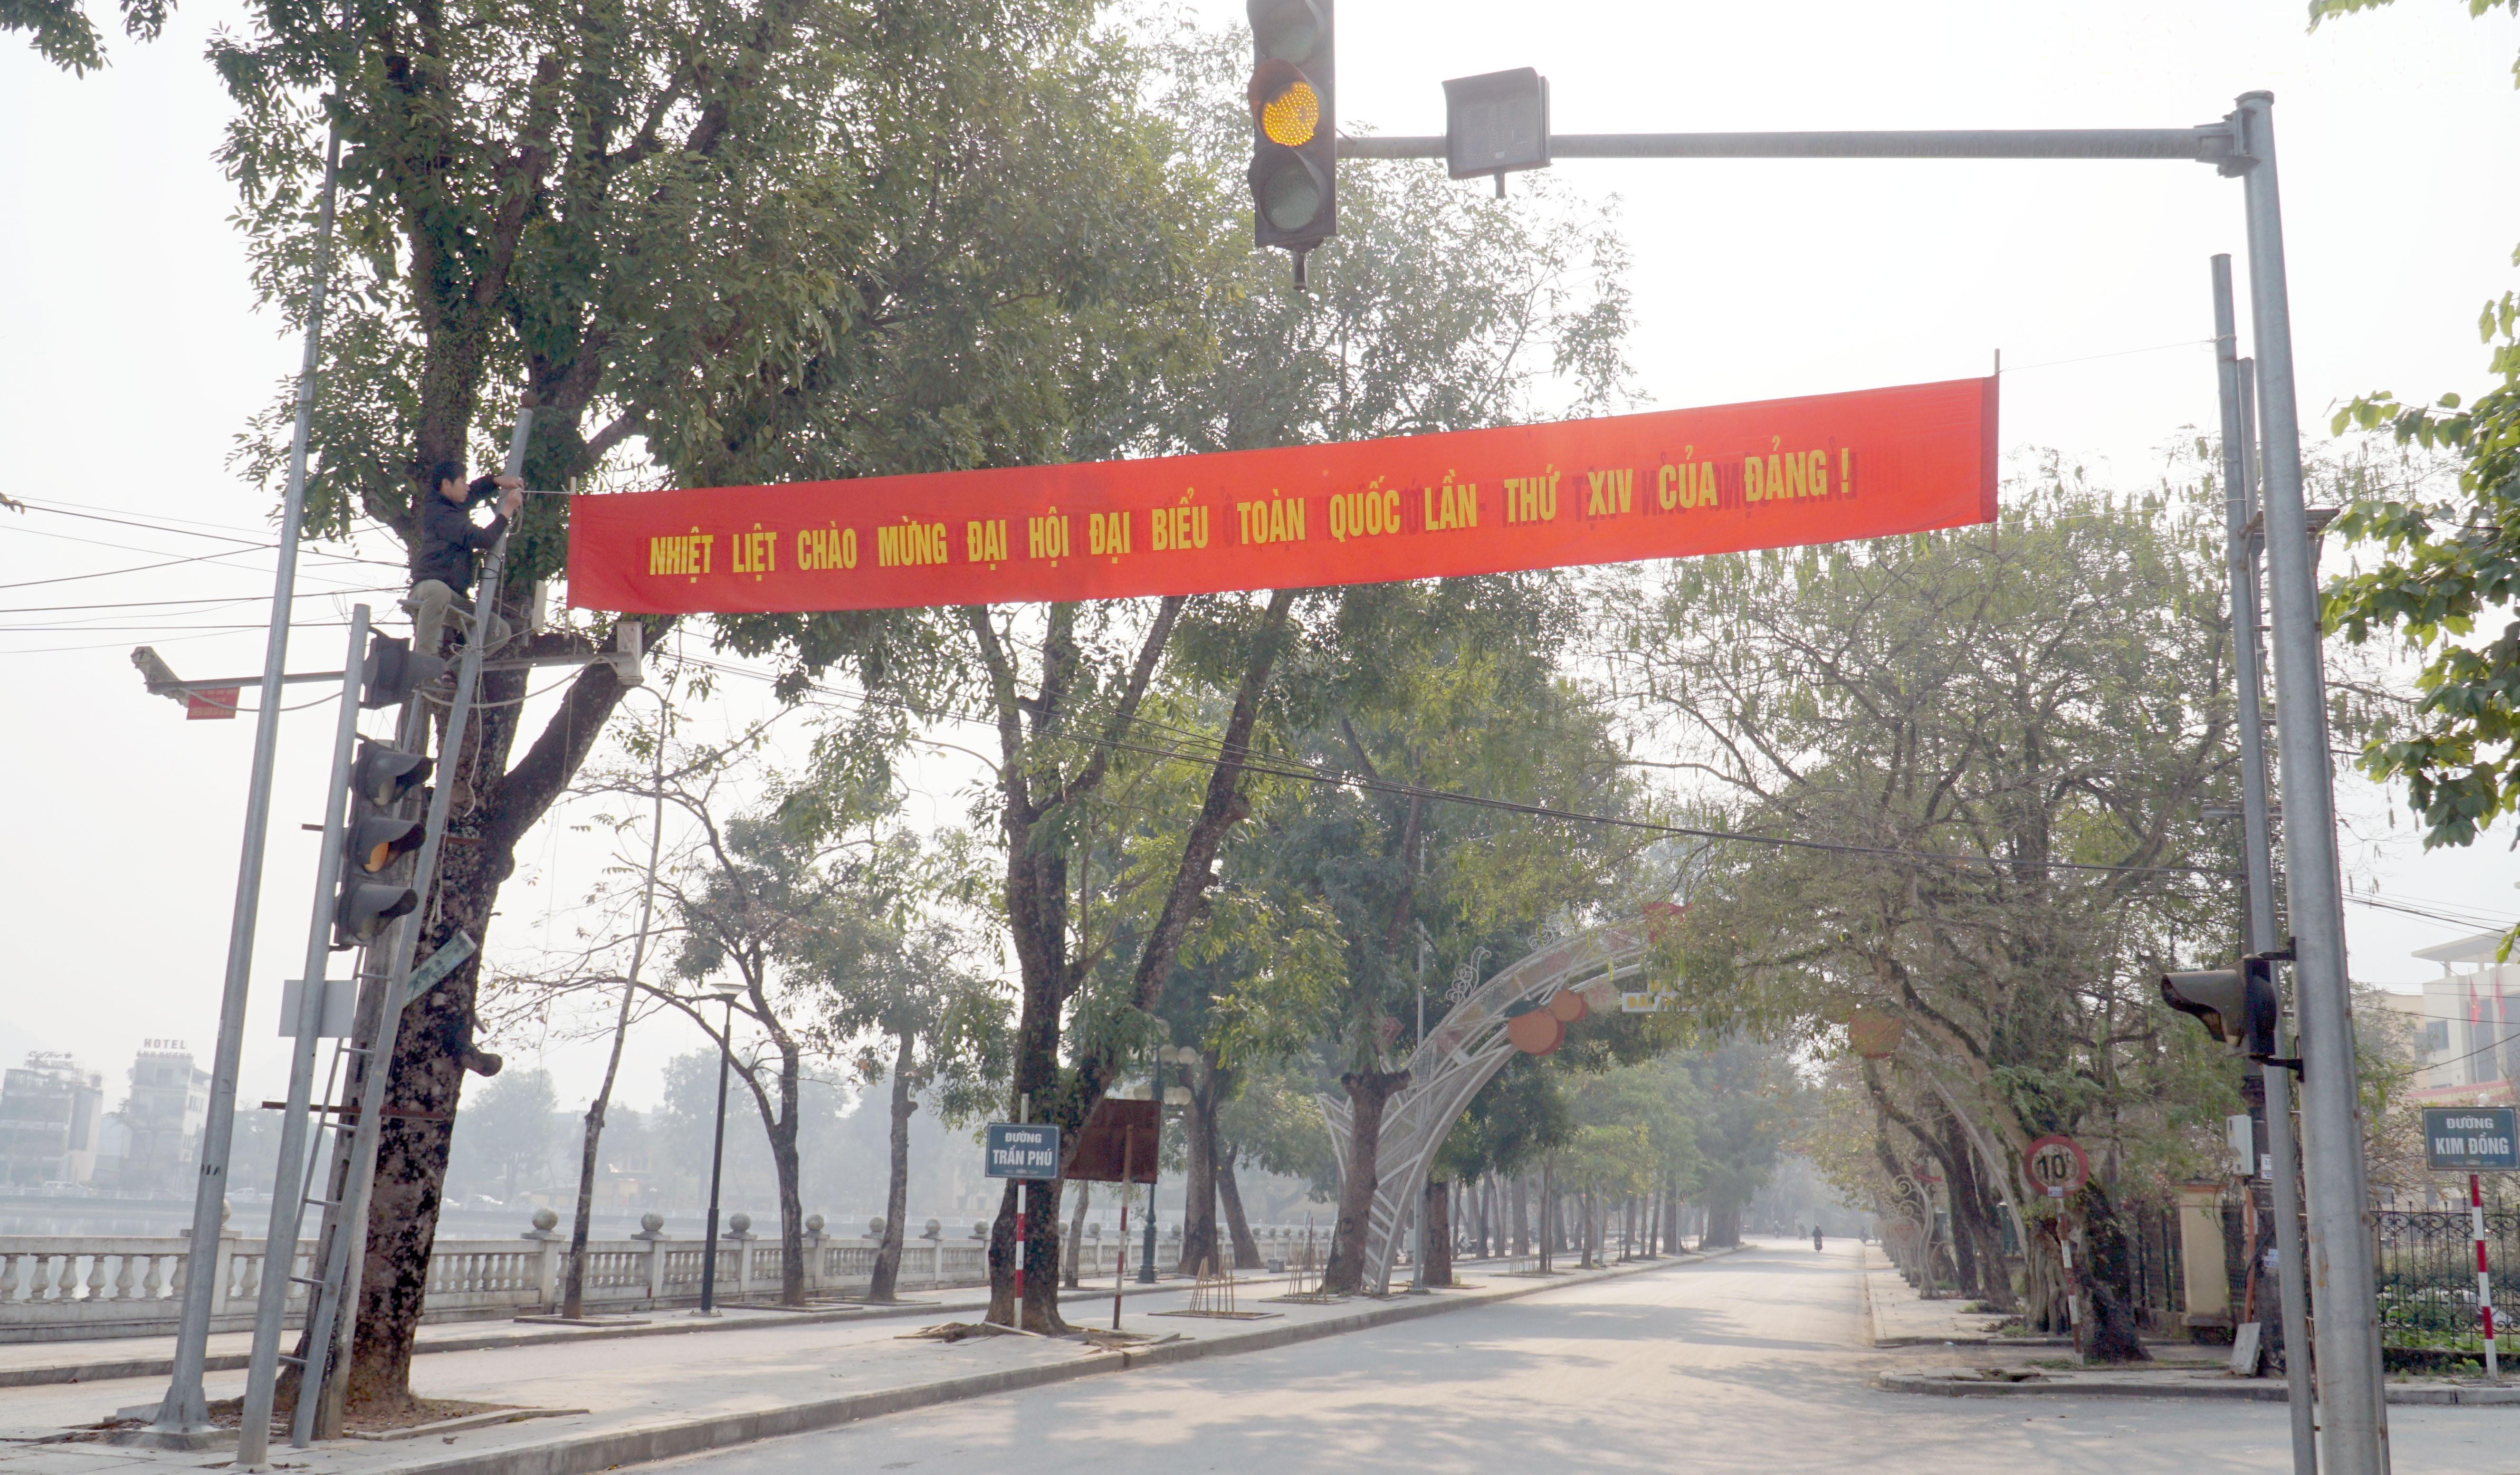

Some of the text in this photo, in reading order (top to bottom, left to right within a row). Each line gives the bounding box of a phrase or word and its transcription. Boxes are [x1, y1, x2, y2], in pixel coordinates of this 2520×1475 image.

[649, 526, 714, 584] NHIỆT
[733, 523, 777, 581] LIỆT
[797, 524, 857, 570] CHÀO
[878, 515, 947, 567] MỪNG
[967, 519, 1007, 571] ĐẠI
[1029, 506, 1069, 567] HỘI
[1089, 511, 1130, 564] ĐẠI
[1152, 487, 1208, 551] BIỂU
[1237, 488, 1305, 545] TOÀN
[1329, 475, 1400, 543] QUỐC
[1424, 469, 1477, 531] LẦN
[1504, 464, 1560, 522] THỨ
[1587, 469, 1633, 516] XIV
[1658, 444, 1718, 510] CỦA
[143, 1038, 186, 1049] HOTEL
[28, 1050, 62, 1059] Coffee
[2445, 1115, 2494, 1129] ĐƯỜNG
[1004, 1130, 1042, 1143] ĐƯỜNG
[2435, 1131, 2509, 1155] KIM ĐỒNG
[993, 1144, 1052, 1166] TRẦN PHÚ
